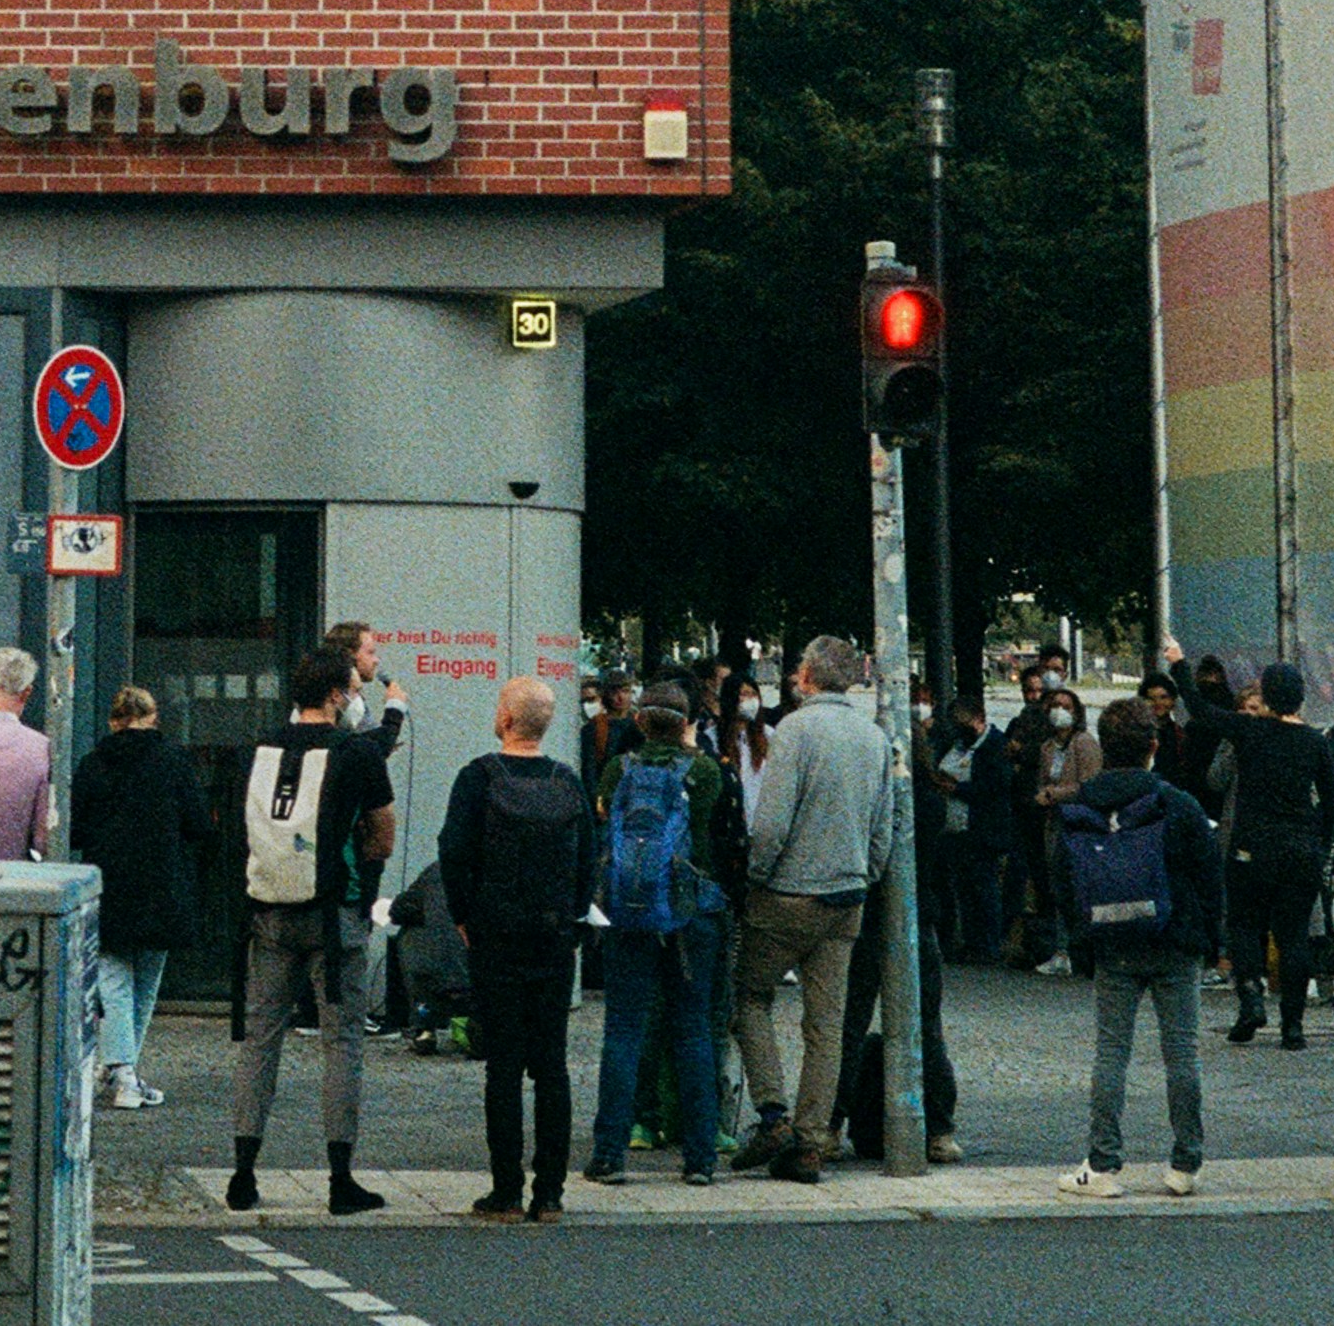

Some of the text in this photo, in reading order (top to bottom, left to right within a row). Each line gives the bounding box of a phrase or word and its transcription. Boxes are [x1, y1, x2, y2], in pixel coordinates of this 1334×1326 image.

[519, 312, 549, 335] 30
[396, 630, 427, 644] bist
[431, 630, 452, 644] Du
[454, 631, 497, 648] richtig
[416, 655, 497, 680] Eingang
